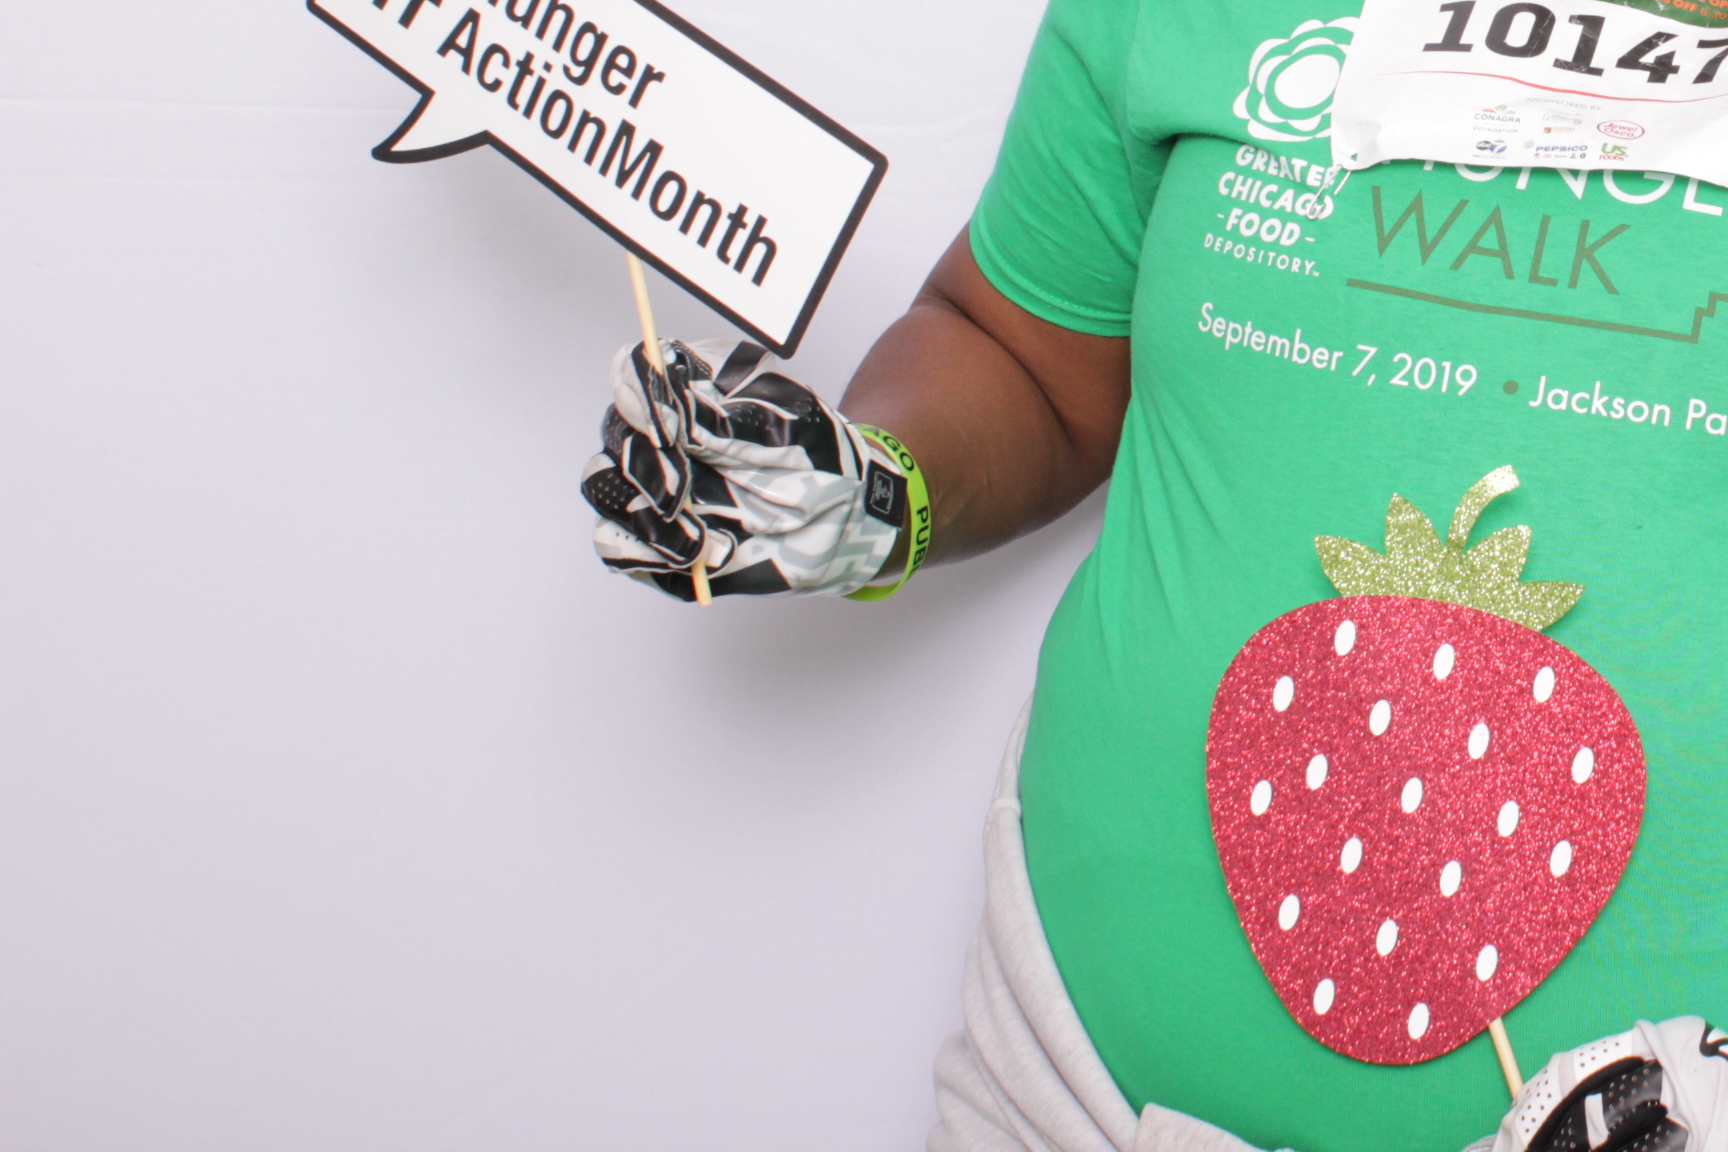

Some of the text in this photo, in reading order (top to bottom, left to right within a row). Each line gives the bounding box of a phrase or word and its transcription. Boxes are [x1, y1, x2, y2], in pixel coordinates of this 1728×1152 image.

[1474, 113, 1521, 123] CONAGRA
[1526, 97, 1587, 109] SPONSORED
[436, 8, 779, 288] ActionMonth
[1473, 126, 1518, 134] FOUNDATION
[1601, 142, 1628, 156] US
[1218, 171, 1334, 219] CHICAGO
[1371, 185, 1632, 296] WALK
[1198, 302, 1478, 397] September 7, 2019
[1528, 375, 1671, 427] Jackson
